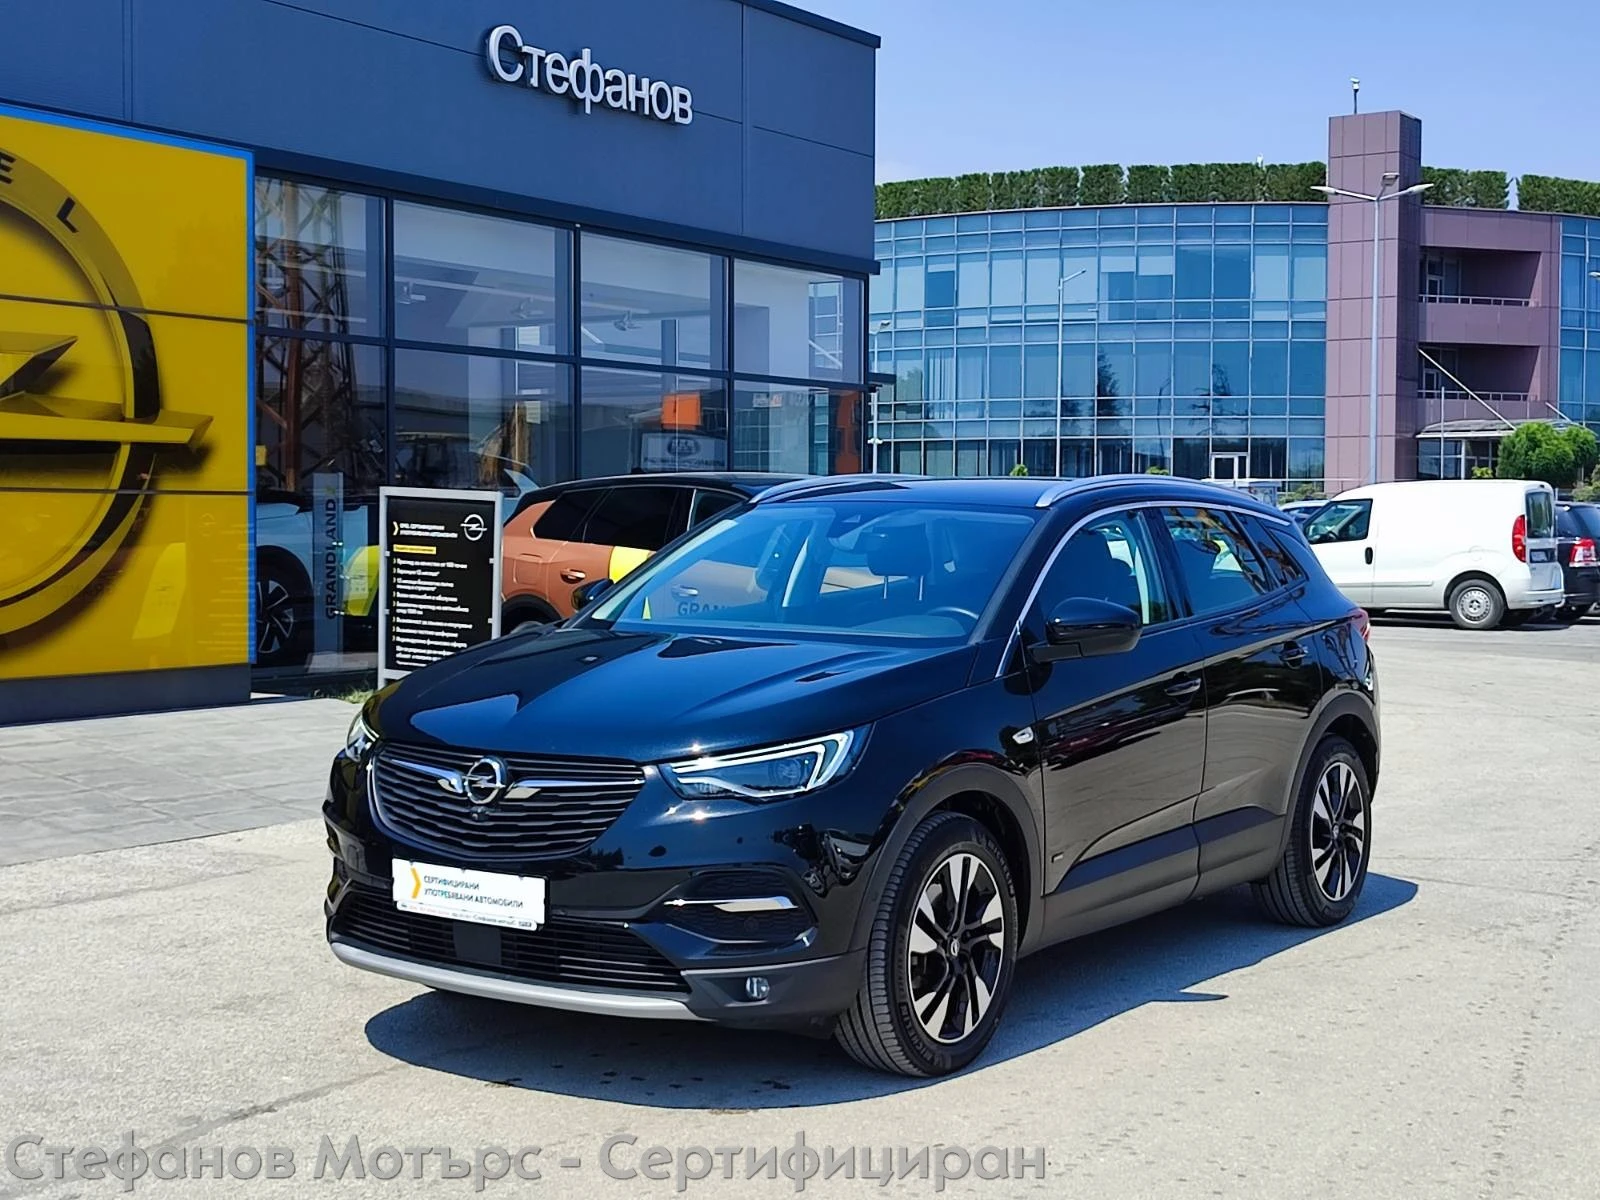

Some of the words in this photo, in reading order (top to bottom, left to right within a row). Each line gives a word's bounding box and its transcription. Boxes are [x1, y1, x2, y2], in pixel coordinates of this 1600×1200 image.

[488, 25, 693, 124] Стефанов
[423, 875, 480, 890] СЕРТИФИЦИРАНИ
[474, 895, 524, 909] АВТОМОБИЛИ
